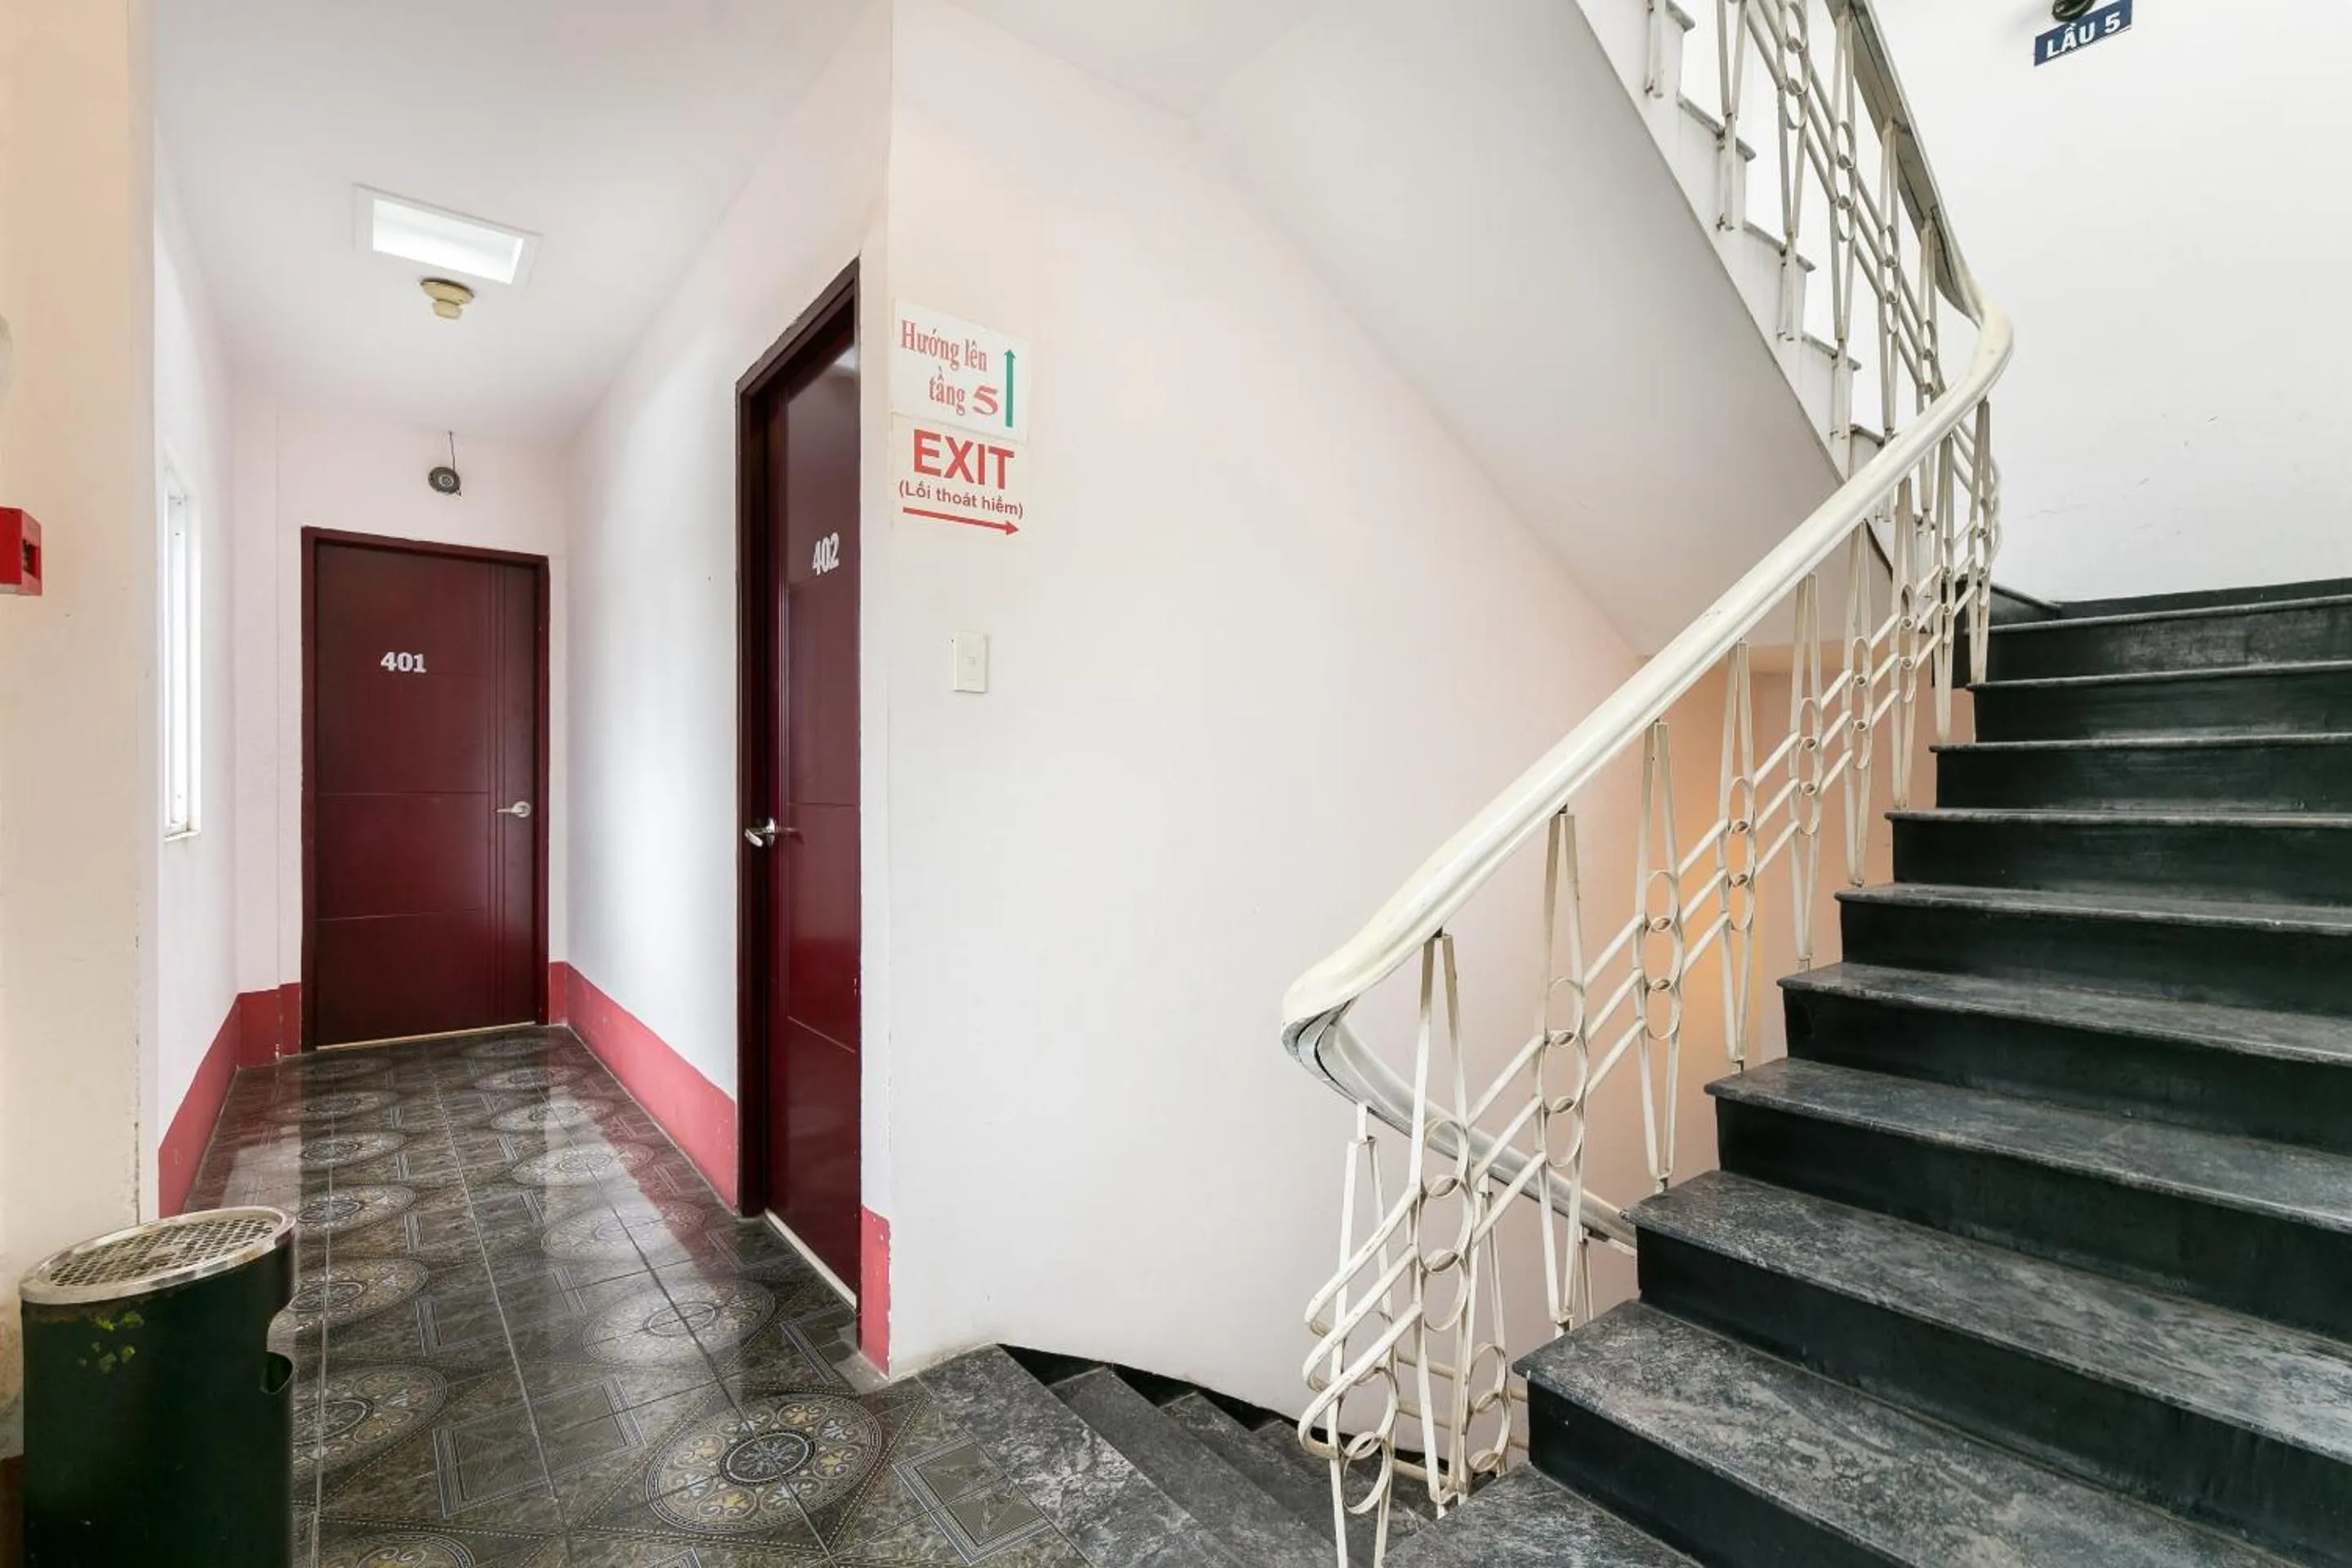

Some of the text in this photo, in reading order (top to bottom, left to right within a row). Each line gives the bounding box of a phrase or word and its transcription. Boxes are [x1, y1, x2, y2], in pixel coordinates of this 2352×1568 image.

[2046, 11, 2121, 58] LẦU 5
[900, 319, 987, 372] Hướng lên
[929, 366, 999, 416] tầng 5
[913, 429, 1015, 490] EXIT
[937, 488, 977, 507] thoát
[812, 532, 840, 576] 402
[381, 652, 426, 673] 401
